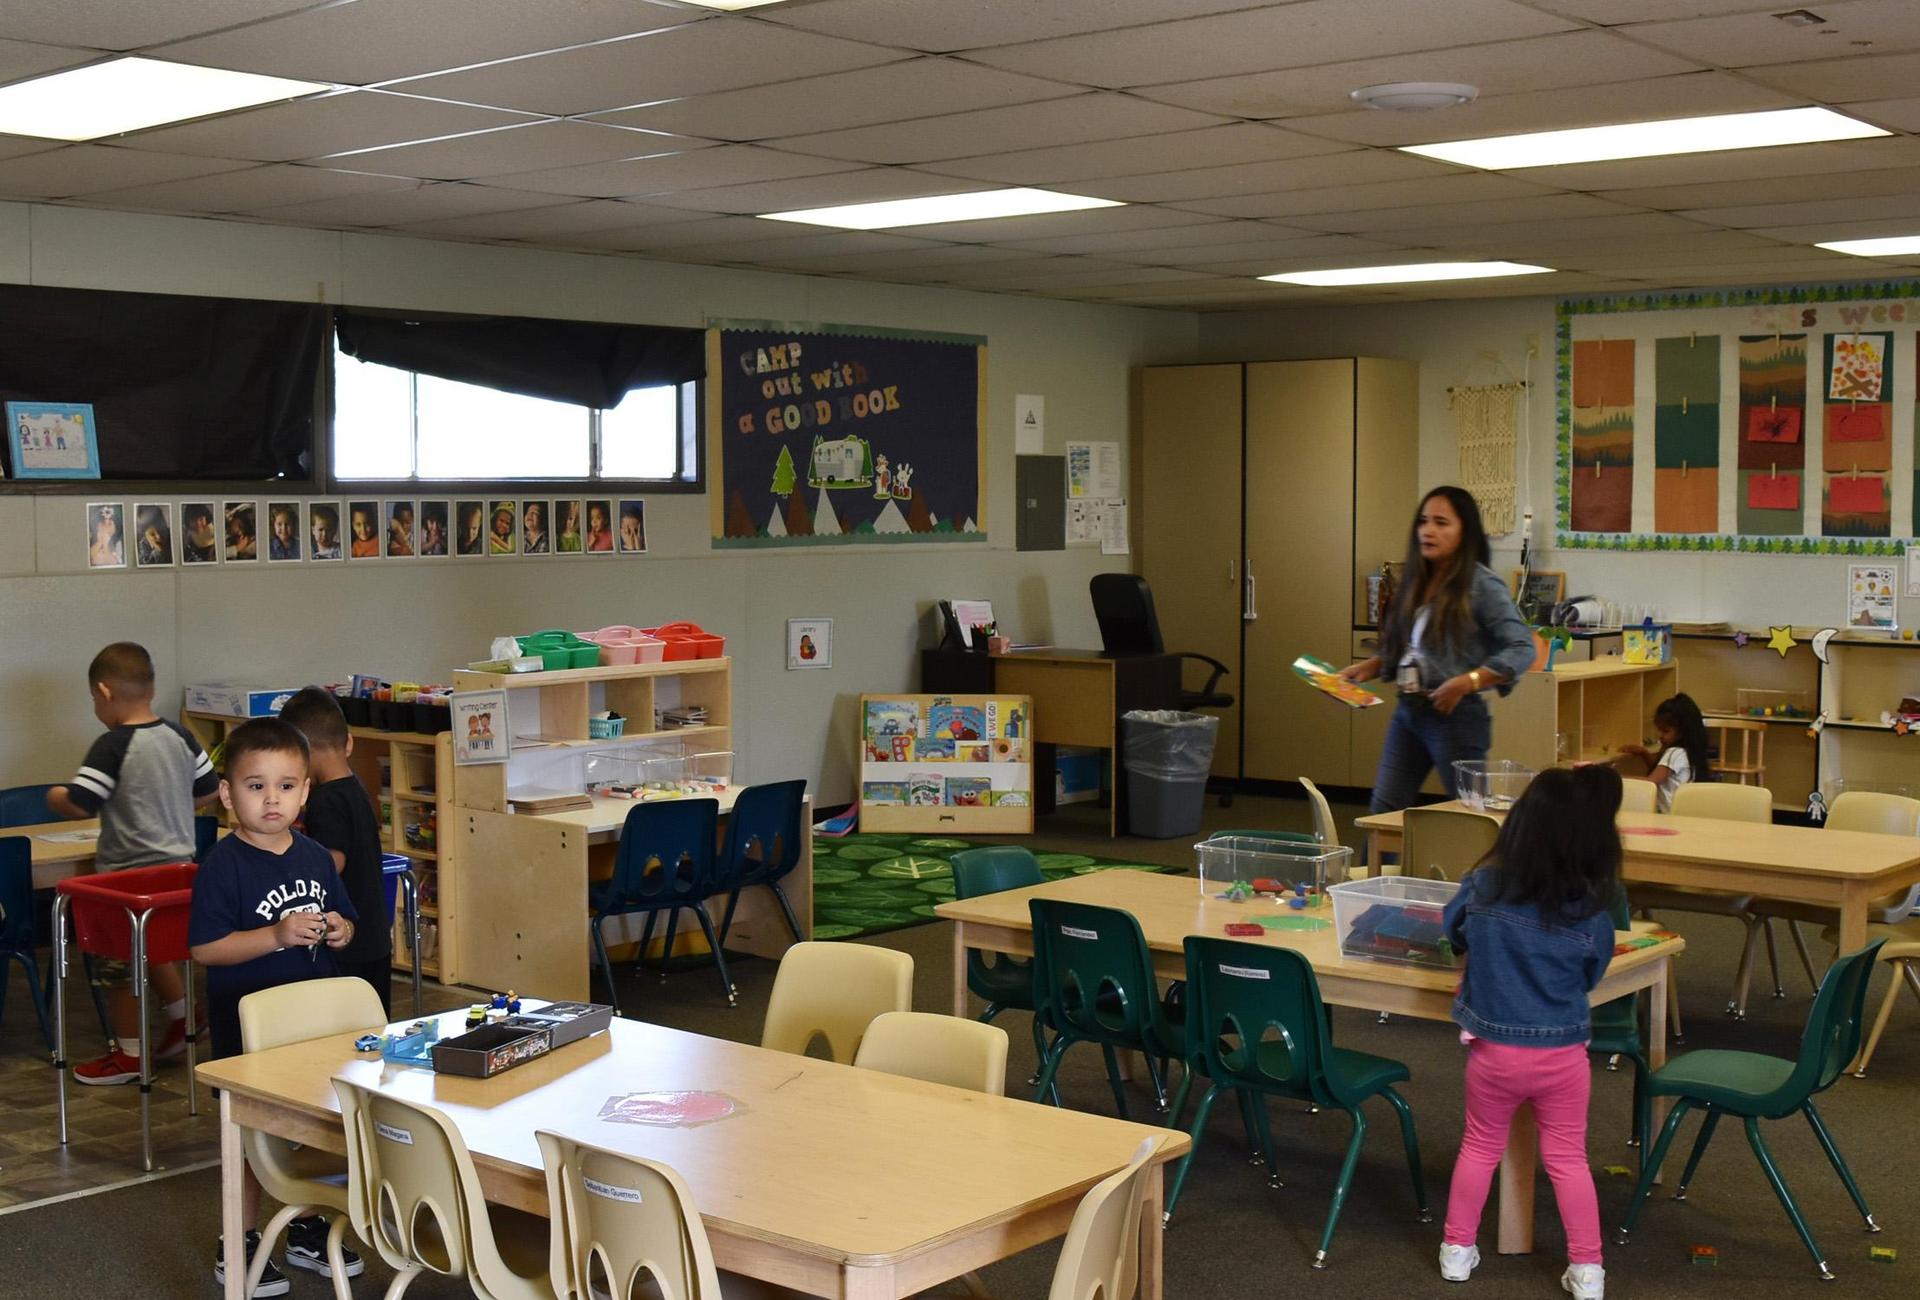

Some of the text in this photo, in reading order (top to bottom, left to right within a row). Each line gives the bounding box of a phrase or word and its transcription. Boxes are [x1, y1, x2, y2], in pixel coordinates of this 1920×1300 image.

[740, 341, 803, 377] CAMP
[761, 360, 870, 400] out with
[738, 384, 902, 435] a GOOD BOOK
[459, 701, 498, 712] Writing Center
[255, 879, 308, 921] POLO
[610, 1186, 640, 1201] Guerrero
